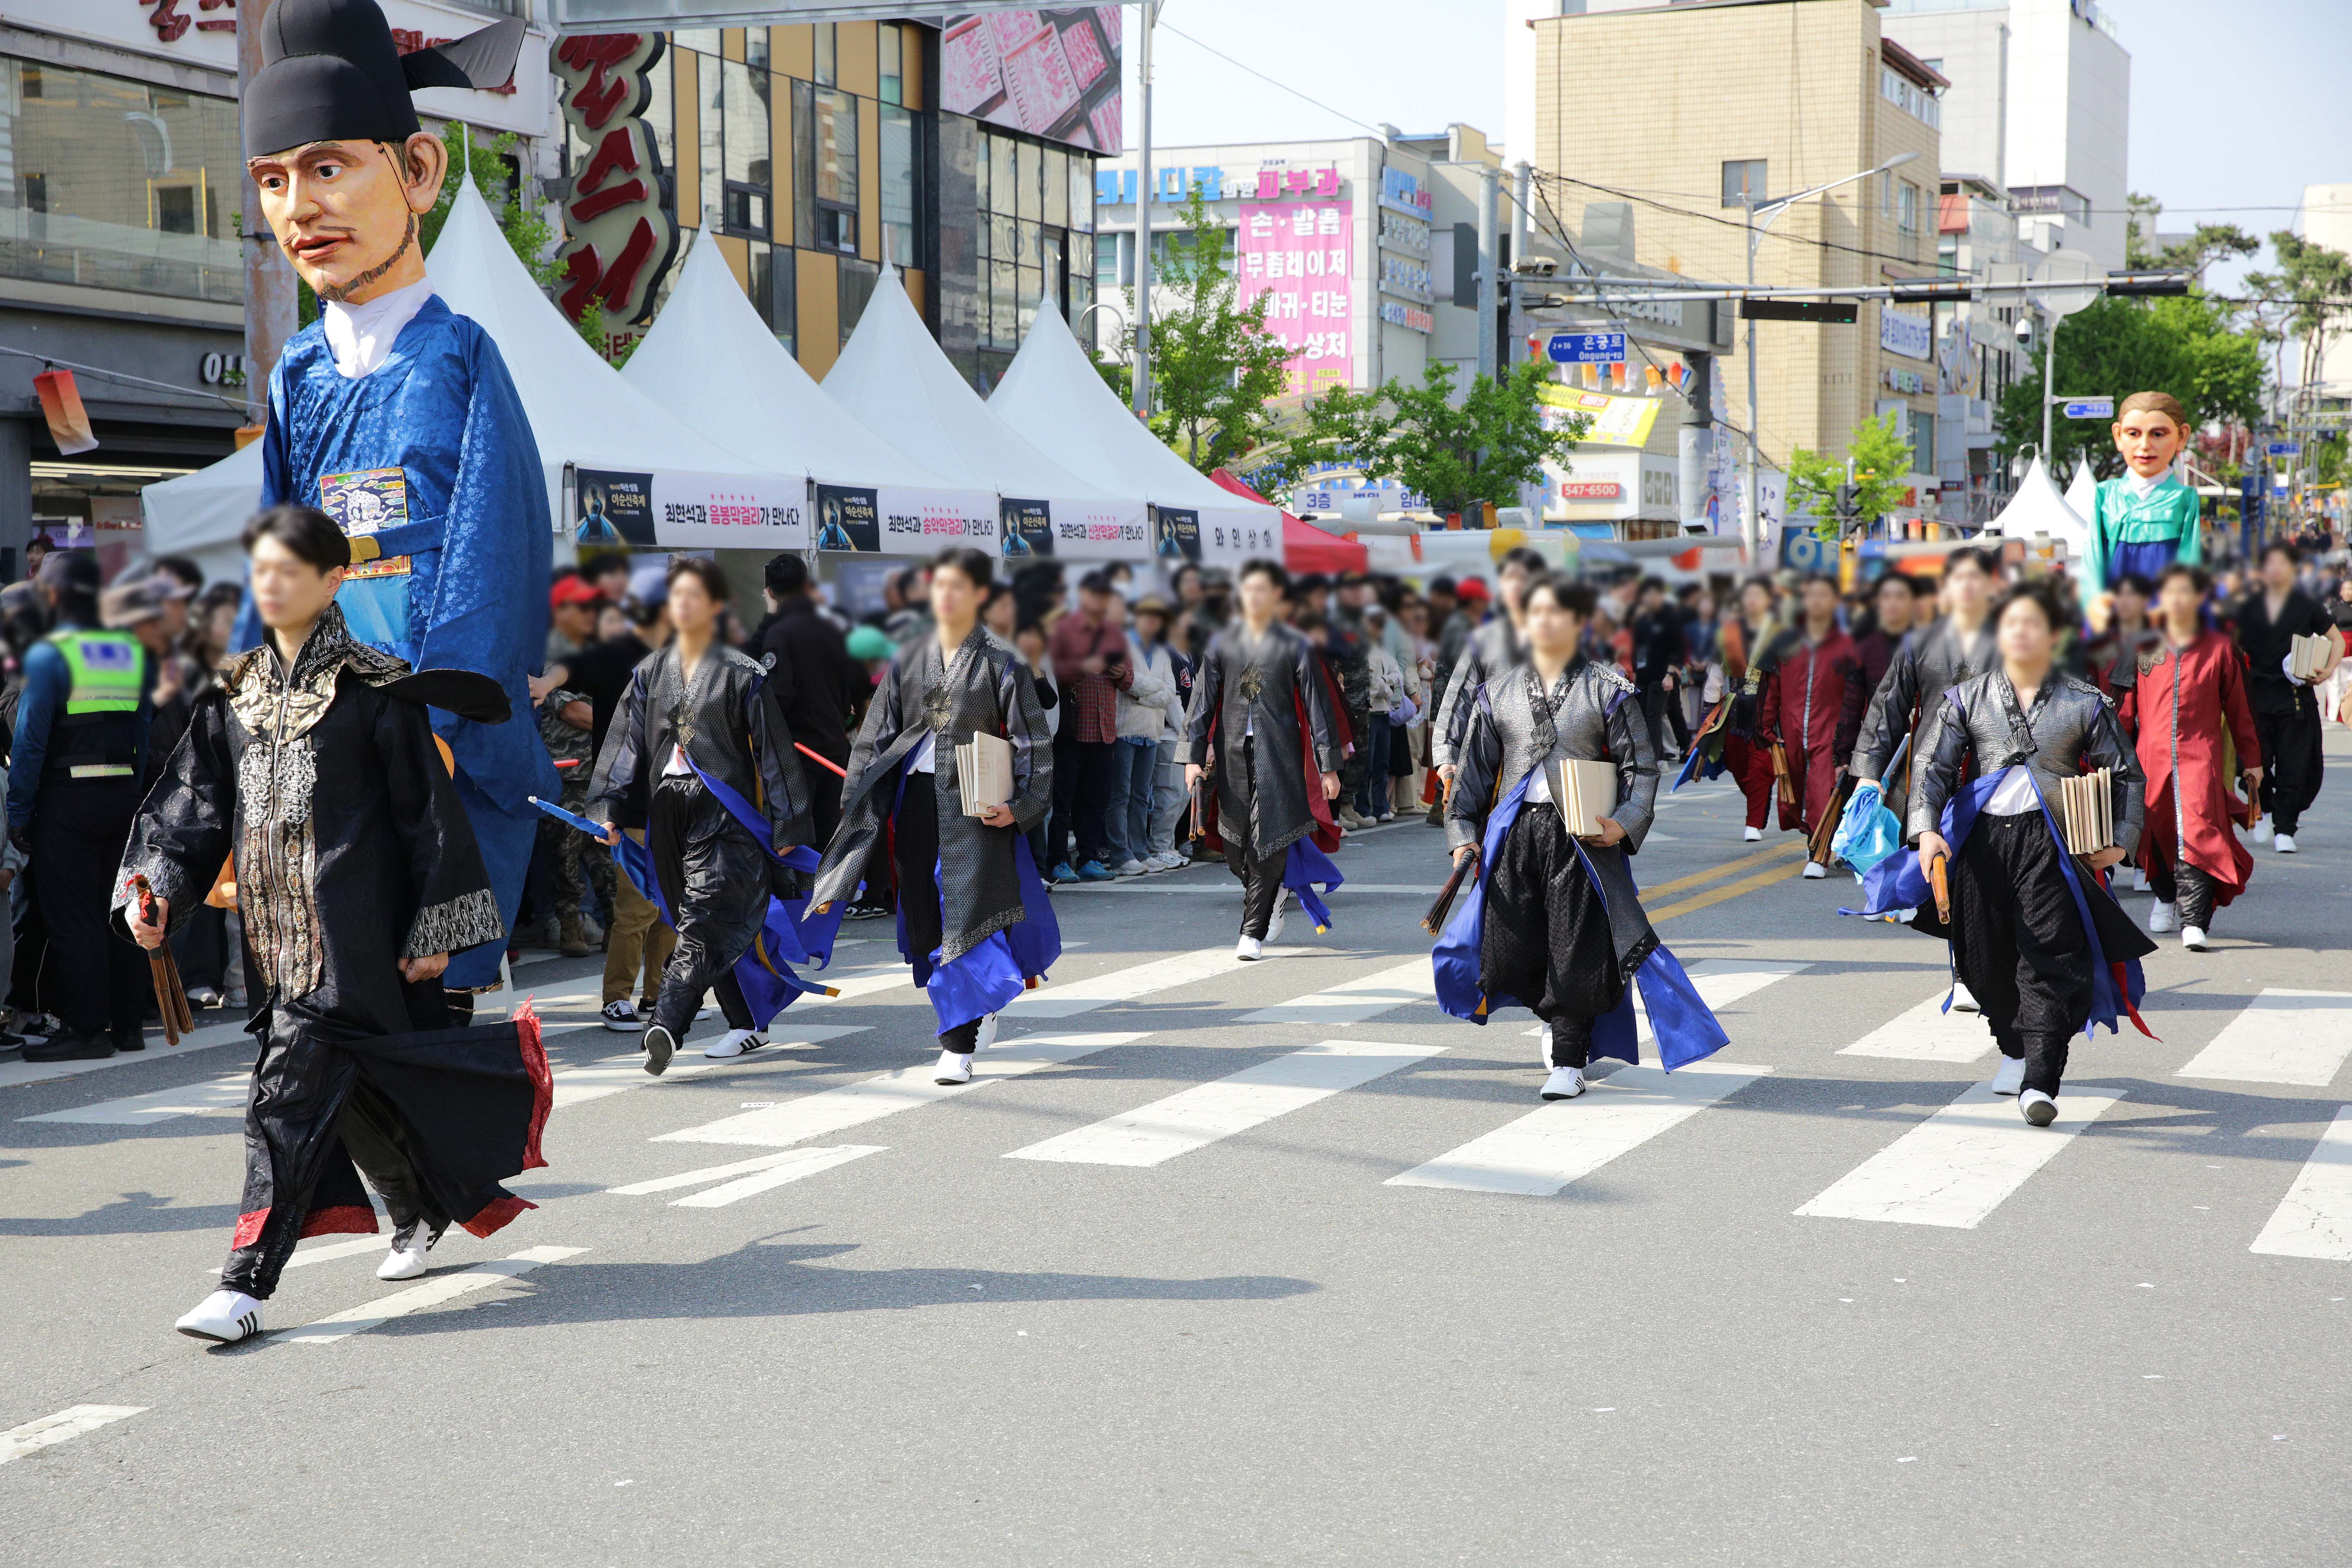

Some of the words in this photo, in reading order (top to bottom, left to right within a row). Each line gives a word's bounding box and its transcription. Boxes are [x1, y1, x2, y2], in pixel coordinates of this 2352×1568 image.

[1256, 168, 1340, 198] 피부과
[1245, 249, 1347, 278] 무좀레이저
[1583, 335, 1623, 350] 온궁로
[1579, 351, 1623, 361] Ongung-ro
[1565, 484, 1616, 496] 547-6500
[611, 493, 646, 507] 이순신축제
[1307, 493, 1331, 509] 3층
[665, 503, 707, 524] 최현석과
[710, 505, 769, 525] 음봉막걸리가
[772, 507, 799, 526] 만나다
[889, 515, 921, 533] 최현석과
[923, 517, 971, 535] 송악막걸리가
[973, 519, 993, 536] 만나다
[1060, 522, 1087, 539] 최현석과
